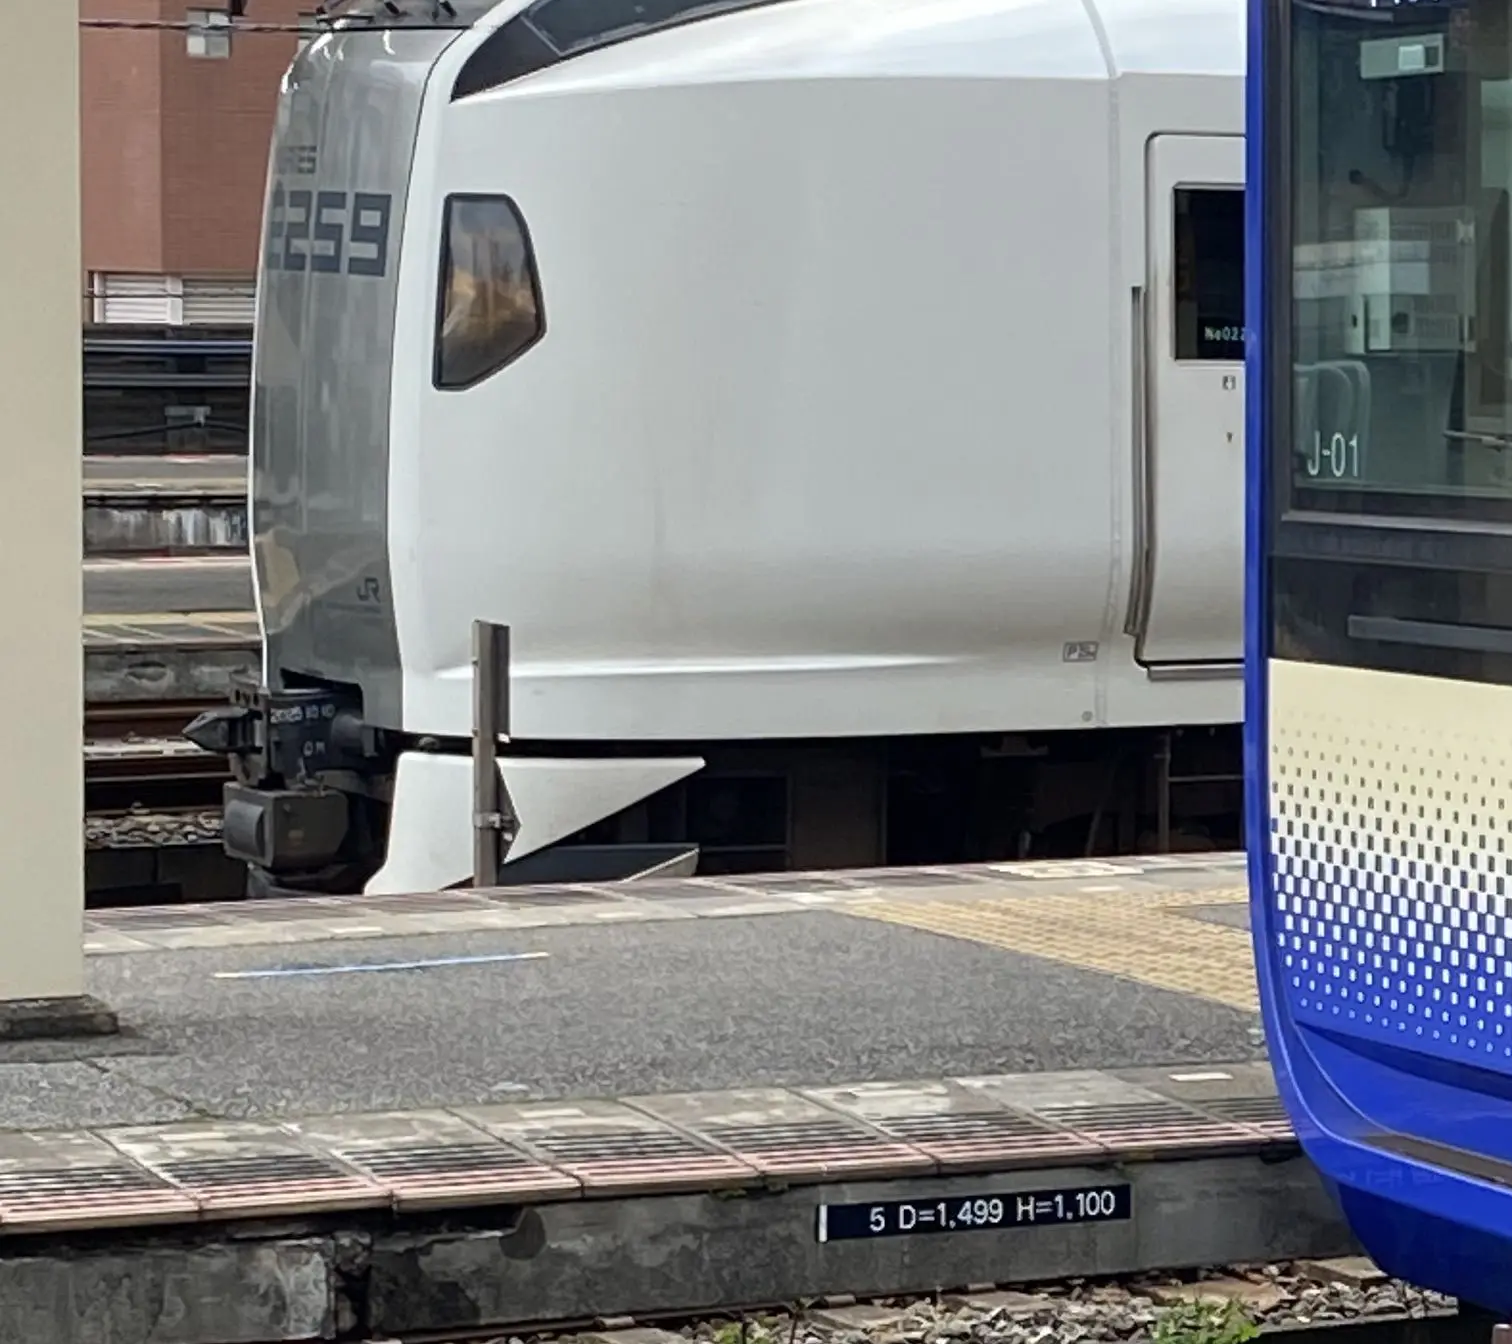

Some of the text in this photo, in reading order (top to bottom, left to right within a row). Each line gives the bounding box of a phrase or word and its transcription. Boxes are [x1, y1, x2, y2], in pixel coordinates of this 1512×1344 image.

[1306, 430, 1359, 477] J-01
[355, 577, 382, 604] JR
[869, 1206, 886, 1233] 5
